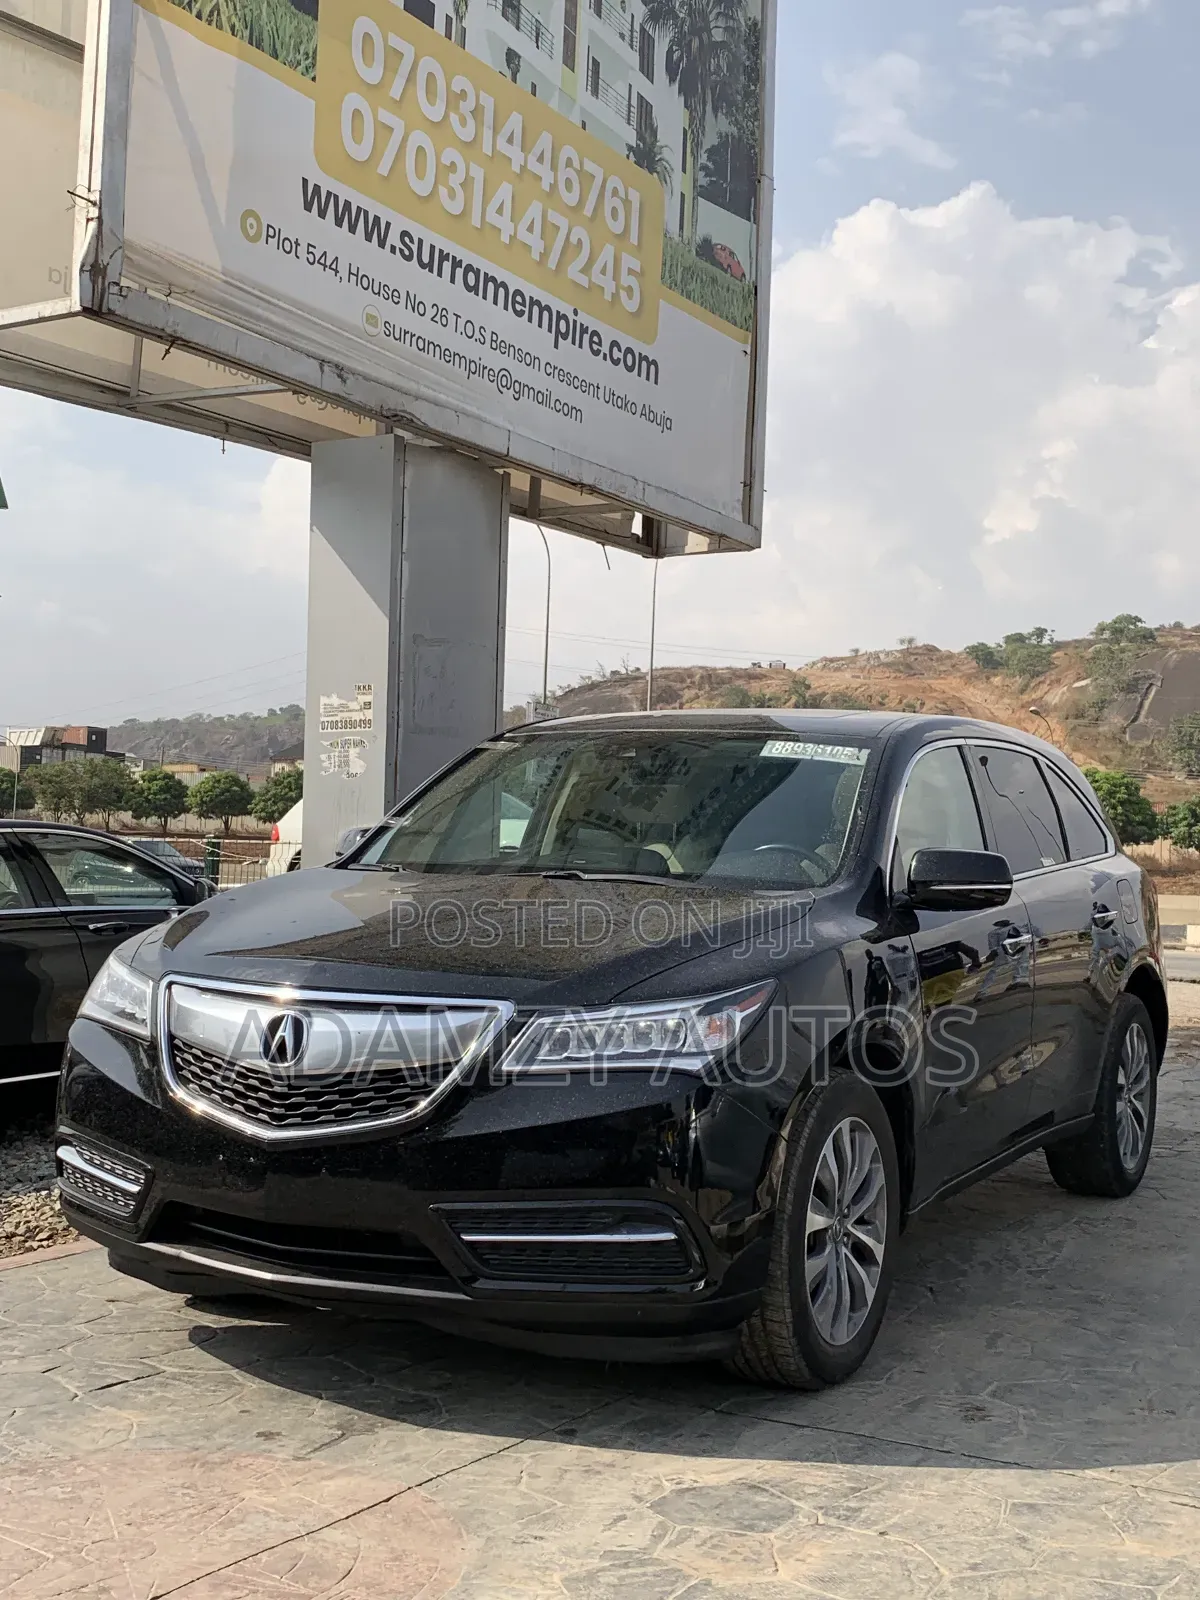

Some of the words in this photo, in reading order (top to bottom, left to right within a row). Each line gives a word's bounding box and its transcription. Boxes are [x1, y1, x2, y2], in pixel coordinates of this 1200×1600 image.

[341, 92, 641, 313] 07031447245
[352, 16, 641, 246] 07031446761
[265, 223, 301, 259] Plot
[306, 243, 343, 283] 544,
[347, 263, 401, 305] House
[405, 290, 426, 317] No
[430, 303, 449, 328] 26
[453, 313, 487, 346] T.O.S
[490, 331, 541, 372] Benson
[544, 361, 600, 400] crescent
[603, 385, 637, 415] Utako
[639, 403, 673, 433] Abuja
[301, 176, 660, 386] www.surramempire.com
[383, 320, 583, 424] surramempire@gmail.com
[320, 718, 372, 730] 07083890499
